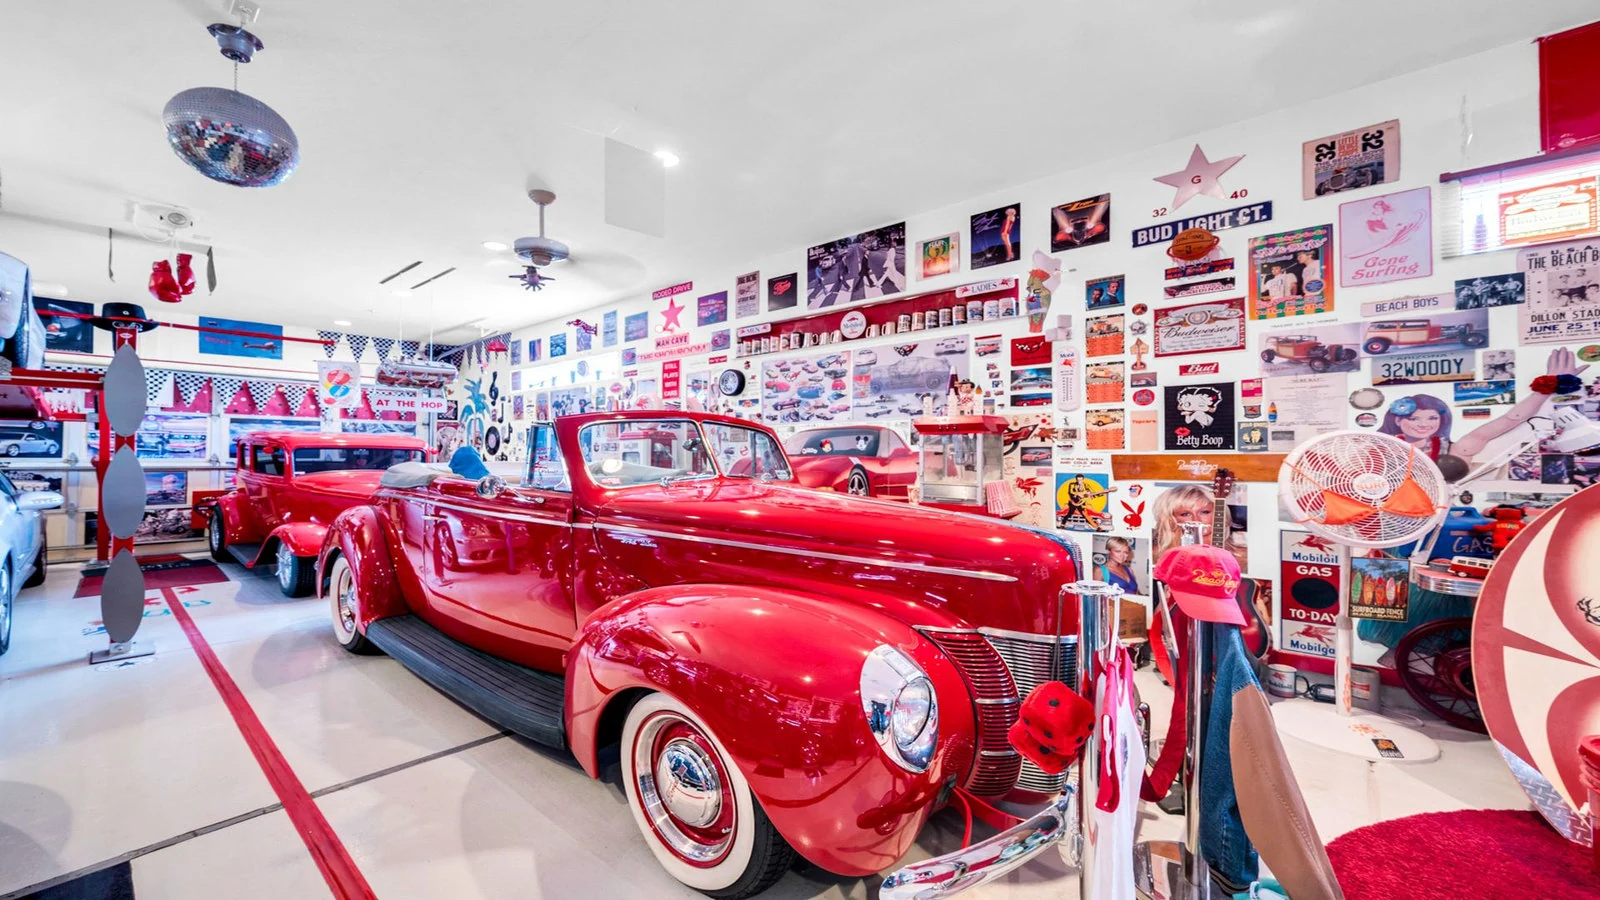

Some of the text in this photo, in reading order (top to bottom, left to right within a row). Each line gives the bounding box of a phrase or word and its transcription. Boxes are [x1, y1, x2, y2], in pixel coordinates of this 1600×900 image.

[1362, 130, 1384, 152] 32
[1315, 141, 1336, 162] 32
[1191, 175, 1201, 184] G
[1230, 189, 1248, 199] 40
[1152, 207, 1167, 218] 32
[1138, 226, 1173, 244] BUD
[1364, 255, 1409, 269] Gone
[1528, 257, 1546, 270] THE
[1551, 251, 1587, 267] BEACH
[1352, 263, 1419, 280] Surfing
[971, 282, 997, 293] LADIES
[1375, 296, 1439, 313] BEACH BOYS
[1531, 312, 1566, 322] DILLON
[747, 326, 760, 334] MEN
[1164, 324, 1235, 339] Budweiser
[1528, 324, 1560, 333] JUNE
[1567, 322, 1584, 330] 25
[656, 335, 688, 347] MAN CAVE
[1187, 362, 1218, 373] Bud
[1381, 358, 1464, 378] 32WOODY
[376, 399, 443, 409] AT THE HOP
[1176, 434, 1224, 448] Betty Boop
[1452, 536, 1495, 554] GAS
[1292, 552, 1338, 564] Mobiloil
[1296, 565, 1332, 577] GAS
[1289, 608, 1338, 623] TO-DAY
[1352, 605, 1404, 616] SURFBOARD FENCE
[1290, 640, 1336, 656] Mobilga
